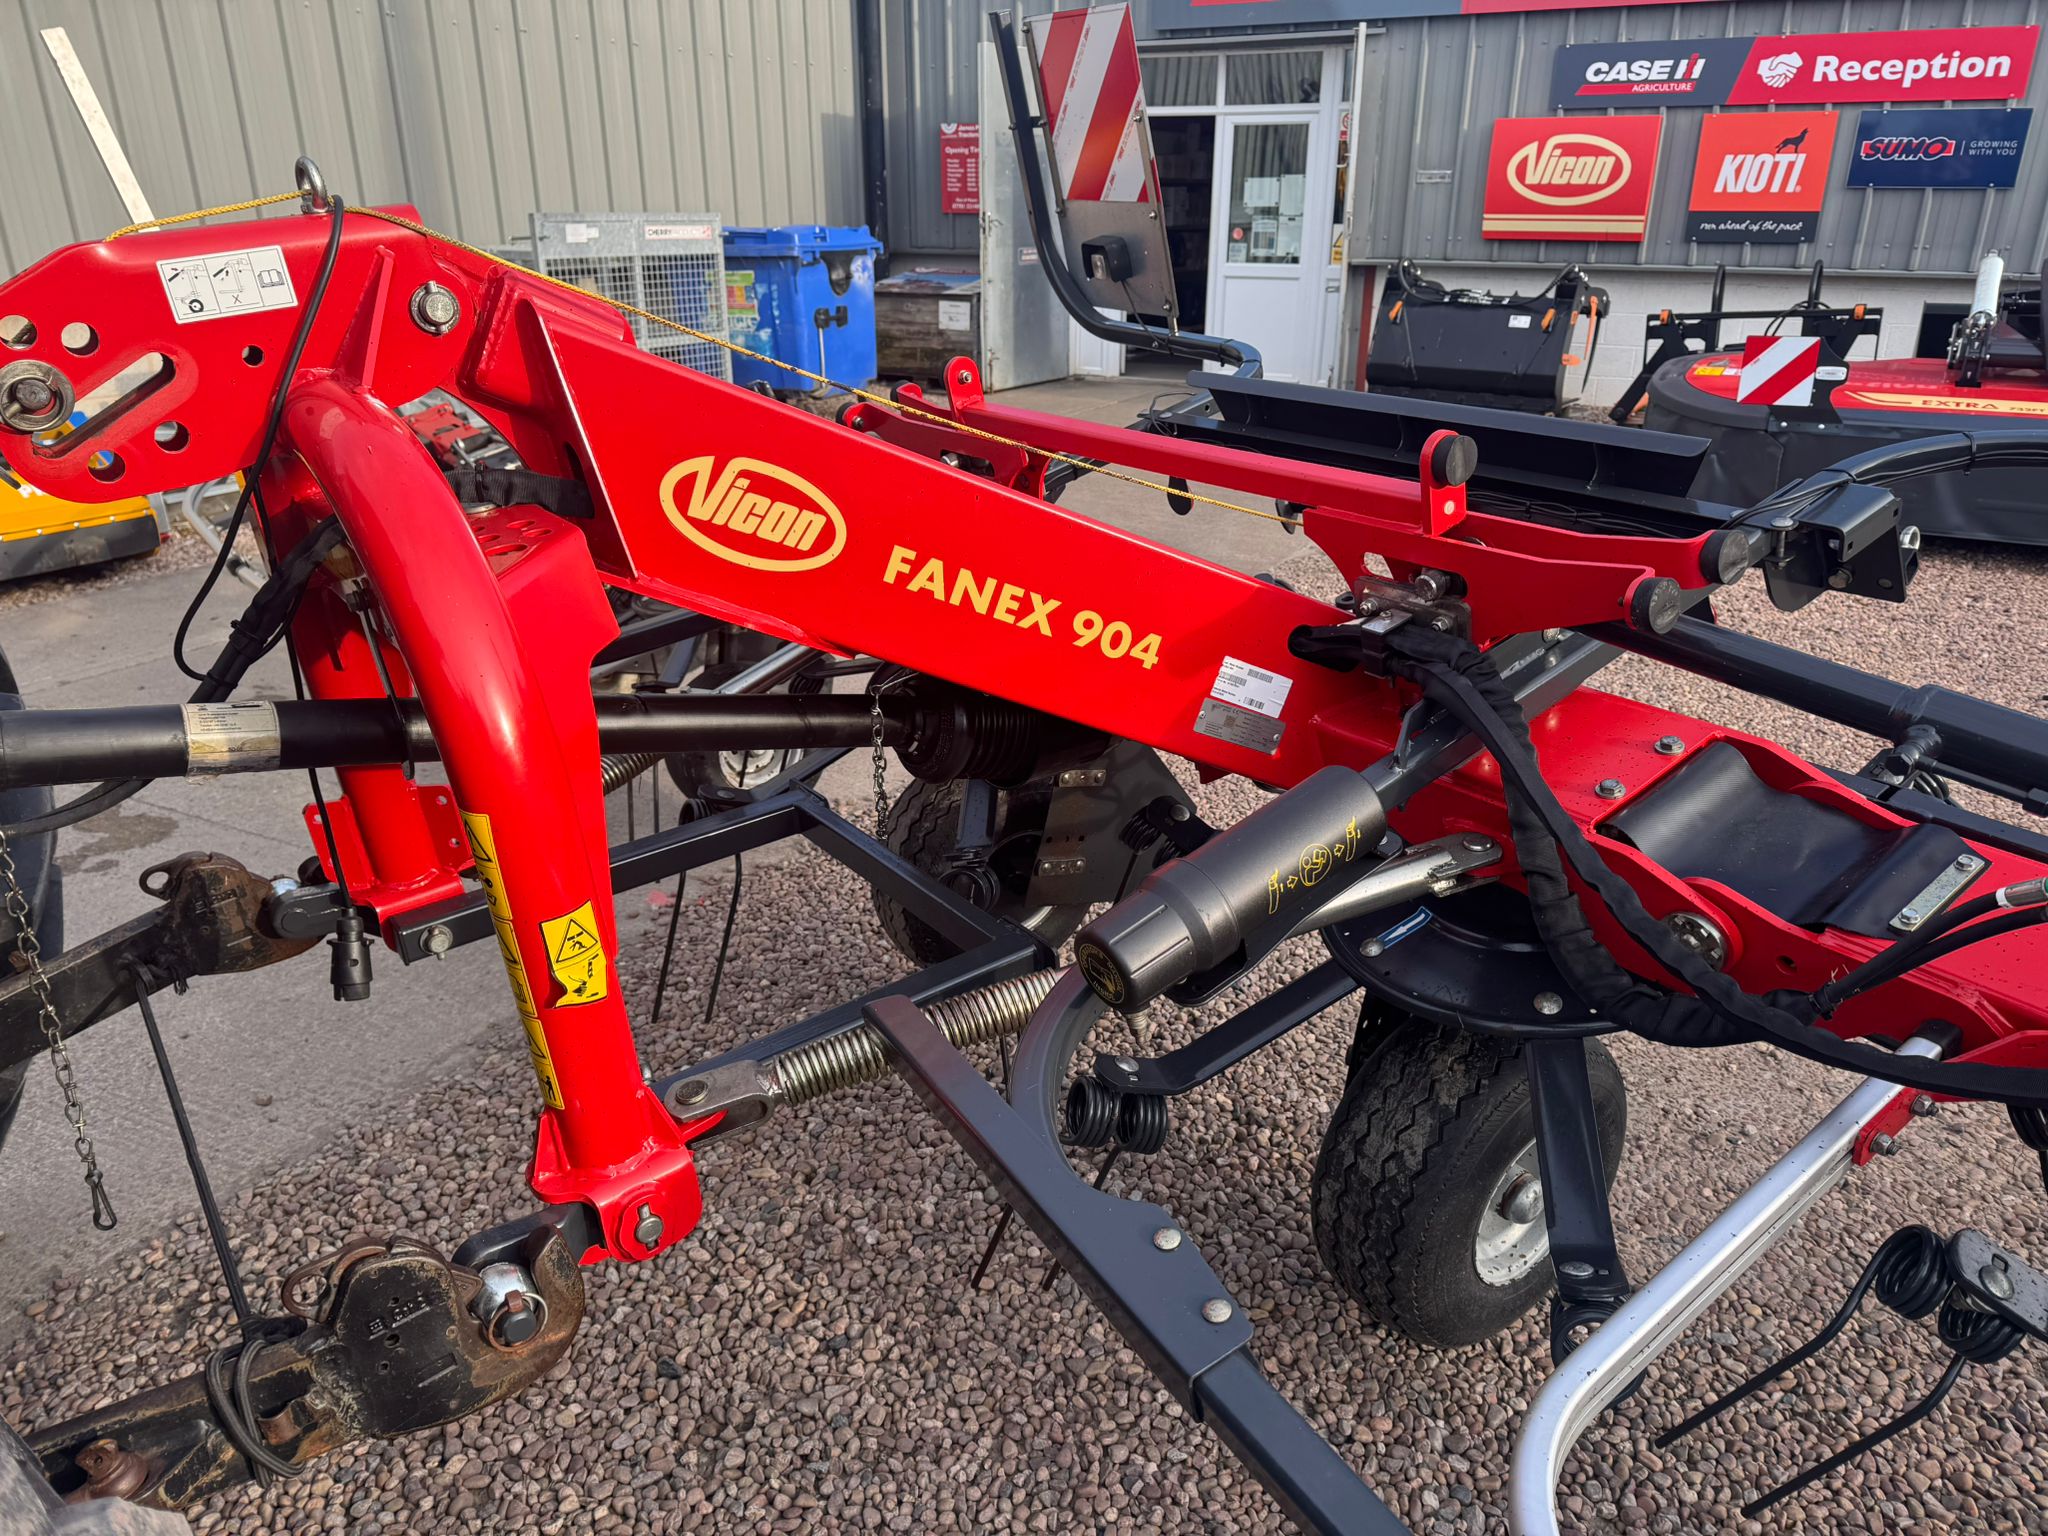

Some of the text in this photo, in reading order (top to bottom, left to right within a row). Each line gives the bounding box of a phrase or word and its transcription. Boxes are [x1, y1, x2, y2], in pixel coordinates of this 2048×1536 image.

[1585, 59, 1674, 82] CASE
[1813, 51, 2011, 88] Reception
[1631, 82, 1693, 92] AGRICULTURE
[1861, 136, 2018, 161] SUMO GROWING
[1968, 148, 2017, 156] WITH YOU
[1700, 220, 1804, 234] run ahead of the pack
[1921, 399, 2000, 410] EXTRA
[882, 544, 1163, 671] FANEX 904
